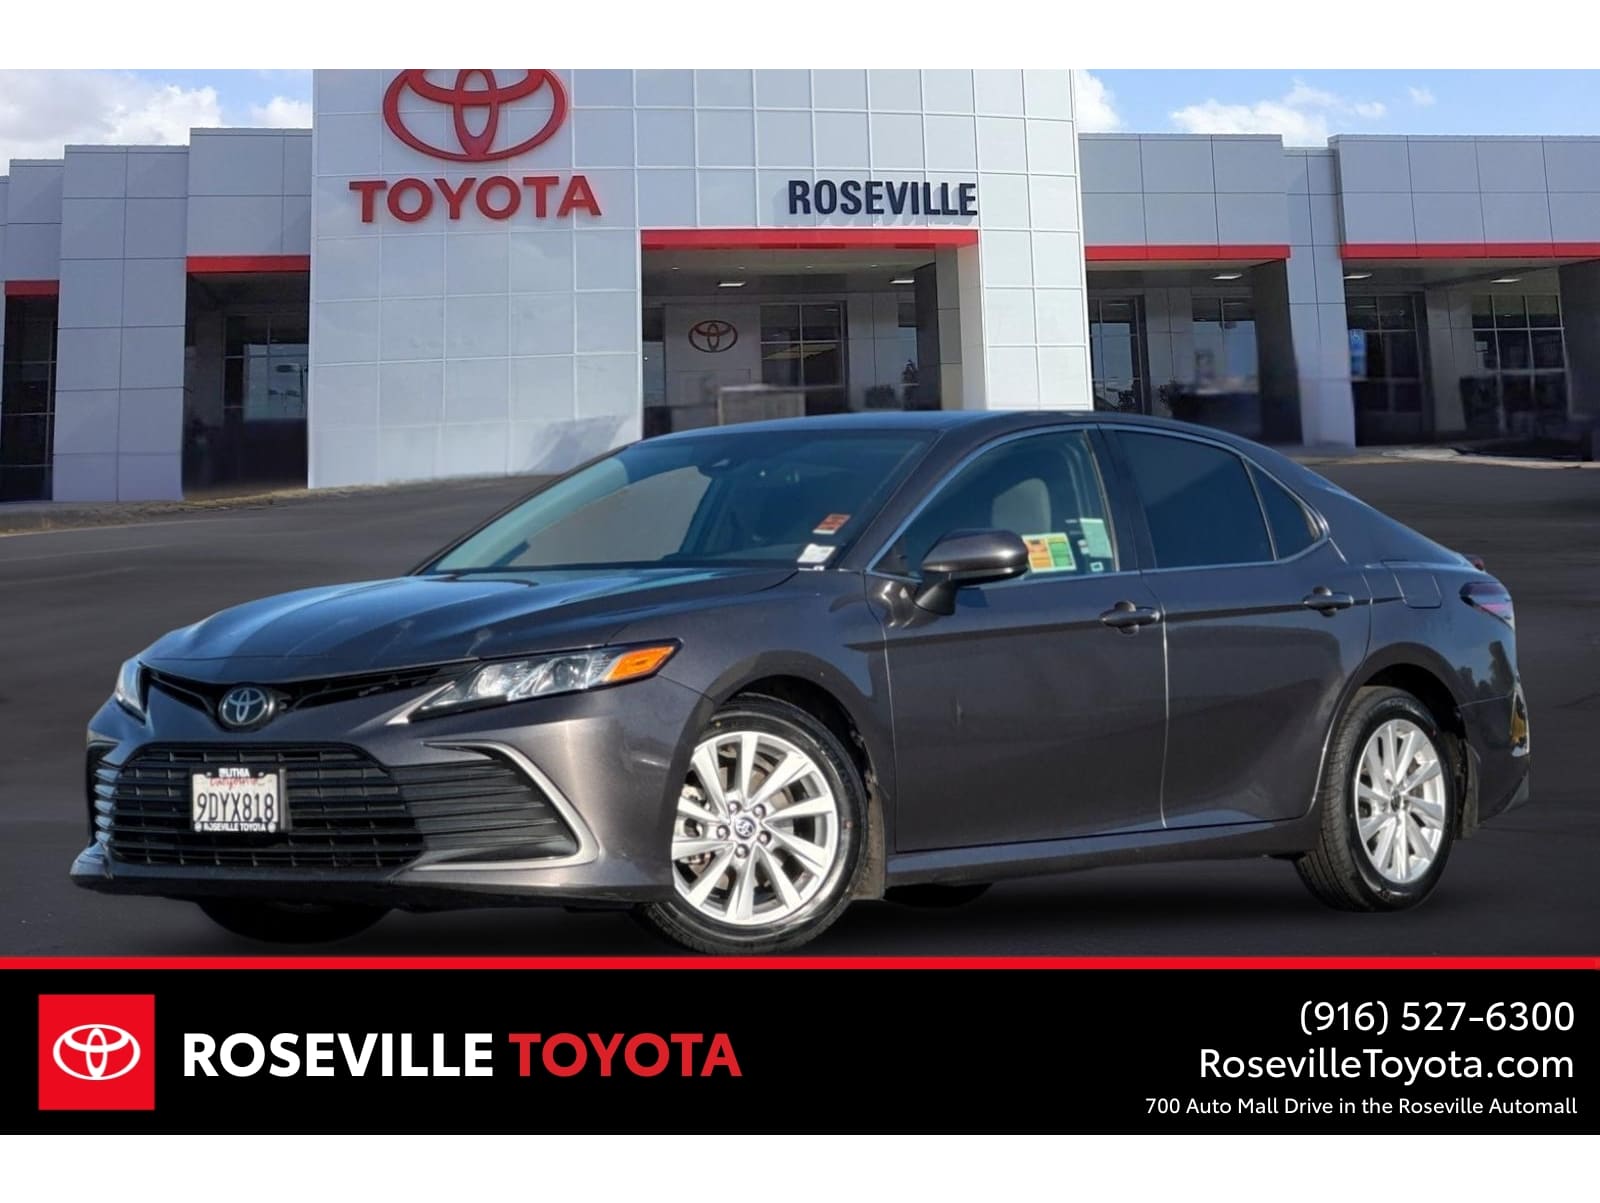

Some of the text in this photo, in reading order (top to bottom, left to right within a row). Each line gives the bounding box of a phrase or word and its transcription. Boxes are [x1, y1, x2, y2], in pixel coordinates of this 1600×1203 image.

[349, 175, 602, 223] TOYOTA
[788, 179, 978, 217] ROSEVILLE
[197, 792, 275, 823] 9DYX818
